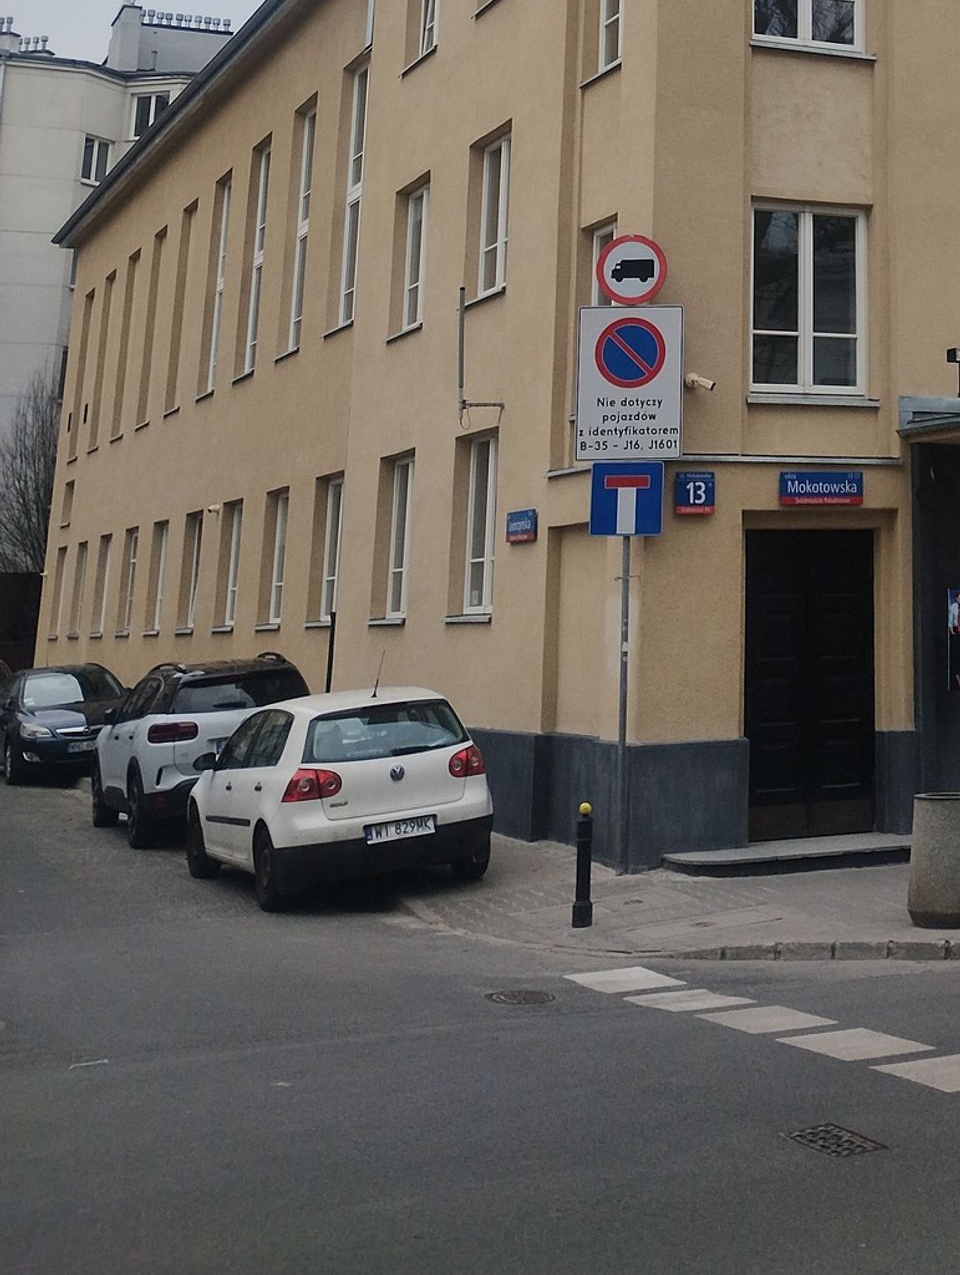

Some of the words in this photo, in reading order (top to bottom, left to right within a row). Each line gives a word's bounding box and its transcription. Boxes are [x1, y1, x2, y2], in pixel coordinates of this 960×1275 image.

[596, 397, 616, 407] Nie
[620, 397, 663, 409] dotyczy
[602, 412, 657, 424] pojazdów
[588, 426, 679, 438] identyfikatorem
[580, 440, 608, 451] B-35
[648, 439, 678, 450] J1601
[686, 481, 706, 504] 13
[787, 479, 858, 494] Mokotowska
